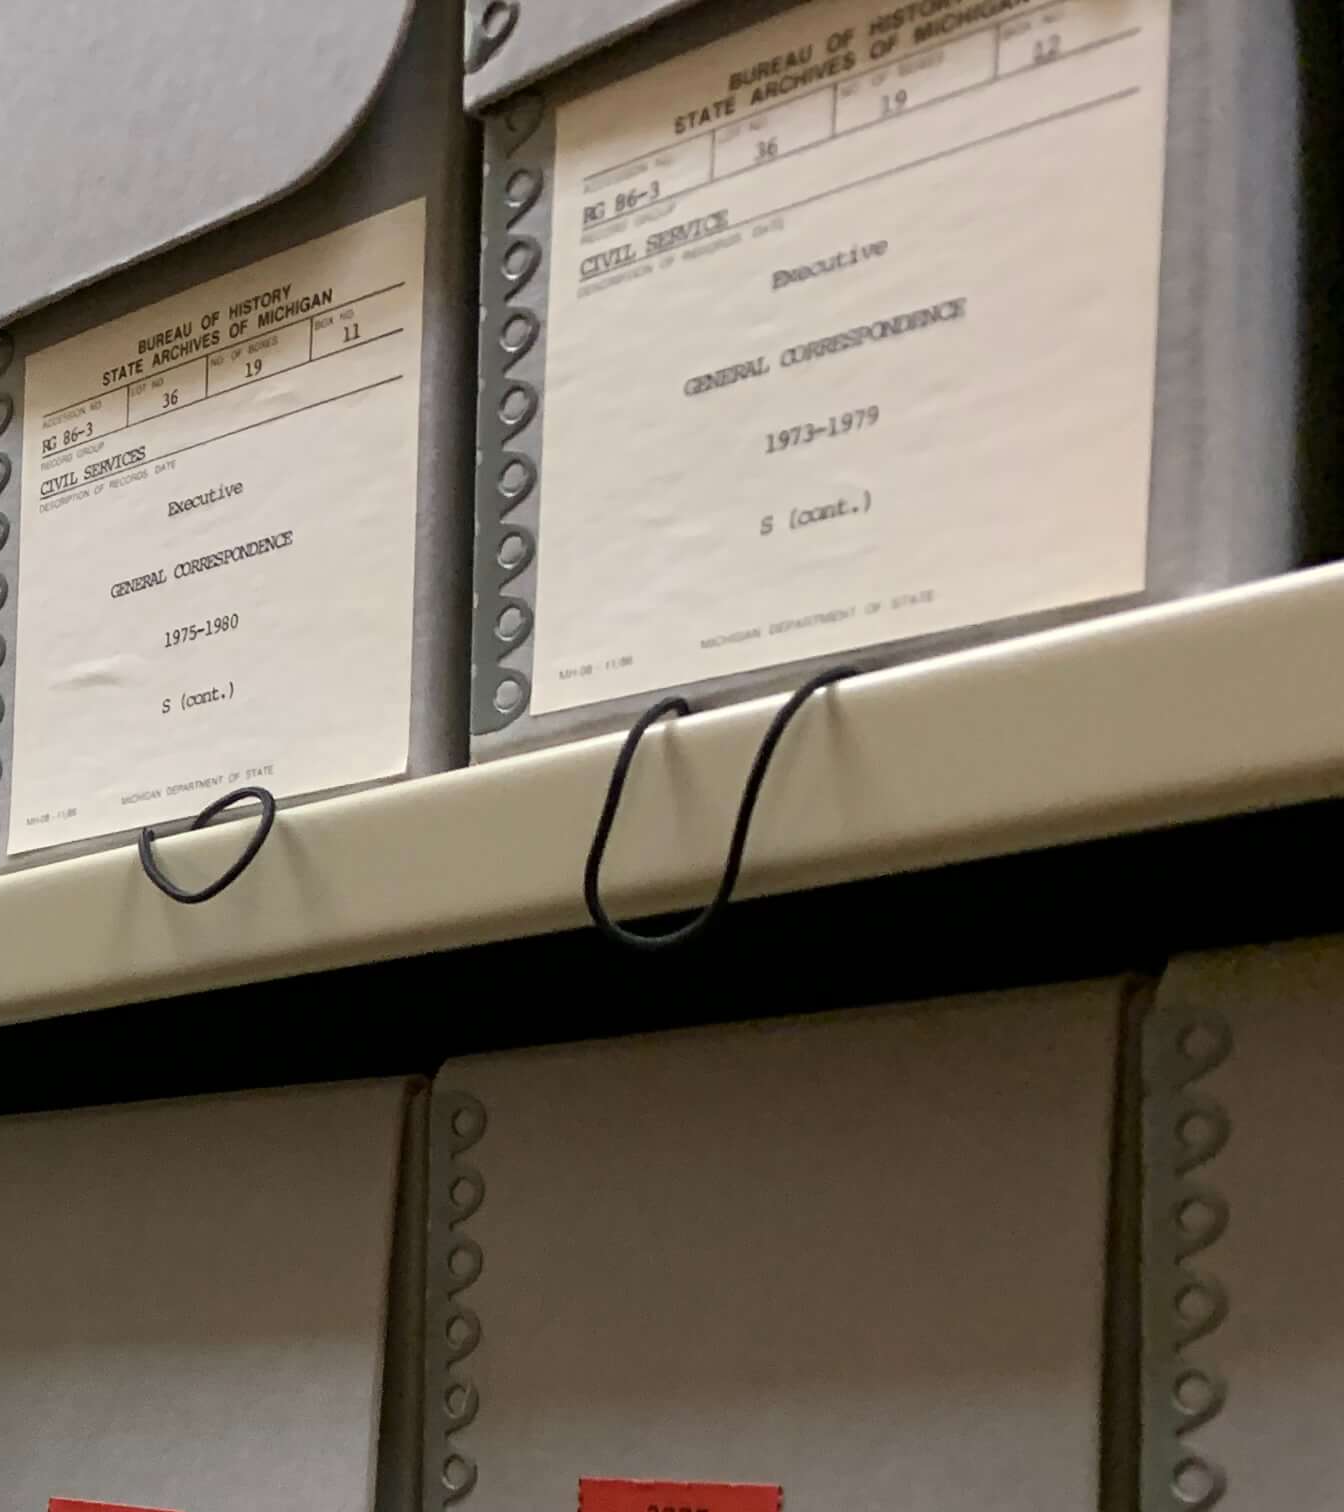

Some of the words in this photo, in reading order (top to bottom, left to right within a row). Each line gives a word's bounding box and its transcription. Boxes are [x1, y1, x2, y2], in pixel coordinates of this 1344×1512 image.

[674, 93, 736, 135] STATE
[750, 52, 856, 106] ARCHIVES
[869, 34, 898, 61] OF
[729, 45, 815, 91] BUREAU
[827, 29, 855, 54] OF
[582, 202, 606, 224] RG
[616, 180, 661, 212] 86-3
[579, 238, 636, 278] CIVIL
[646, 210, 729, 254] SERVICE
[771, 240, 889, 291] Executive
[102, 360, 144, 387] STATE
[152, 330, 221, 368] ARCHIVES
[229, 320, 249, 339] OF
[258, 288, 334, 330] MICHIGAN
[138, 323, 193, 355] BUREAU
[201, 310, 221, 331] OF
[229, 283, 292, 321] HISTORY
[342, 323, 361, 343] 11
[244, 358, 263, 379] 19
[683, 357, 770, 397] GENERAL
[779, 298, 968, 369] CORRESPONDENCE
[162, 388, 179, 409] 36
[41, 439, 57, 454] RG
[63, 422, 93, 444] 86-3
[764, 405, 880, 454] 1973-1979
[40, 471, 78, 496] CIVIL
[83, 445, 147, 482] SERVICES
[167, 480, 244, 518] Executive
[760, 514, 774, 537] S
[789, 490, 873, 530] (cont.)
[110, 569, 167, 599] GENERAL
[174, 530, 294, 579] CORRESPONDENCE
[164, 612, 240, 648] 1975-1980
[161, 698, 171, 714] S
[180, 681, 236, 711] (cont.)
